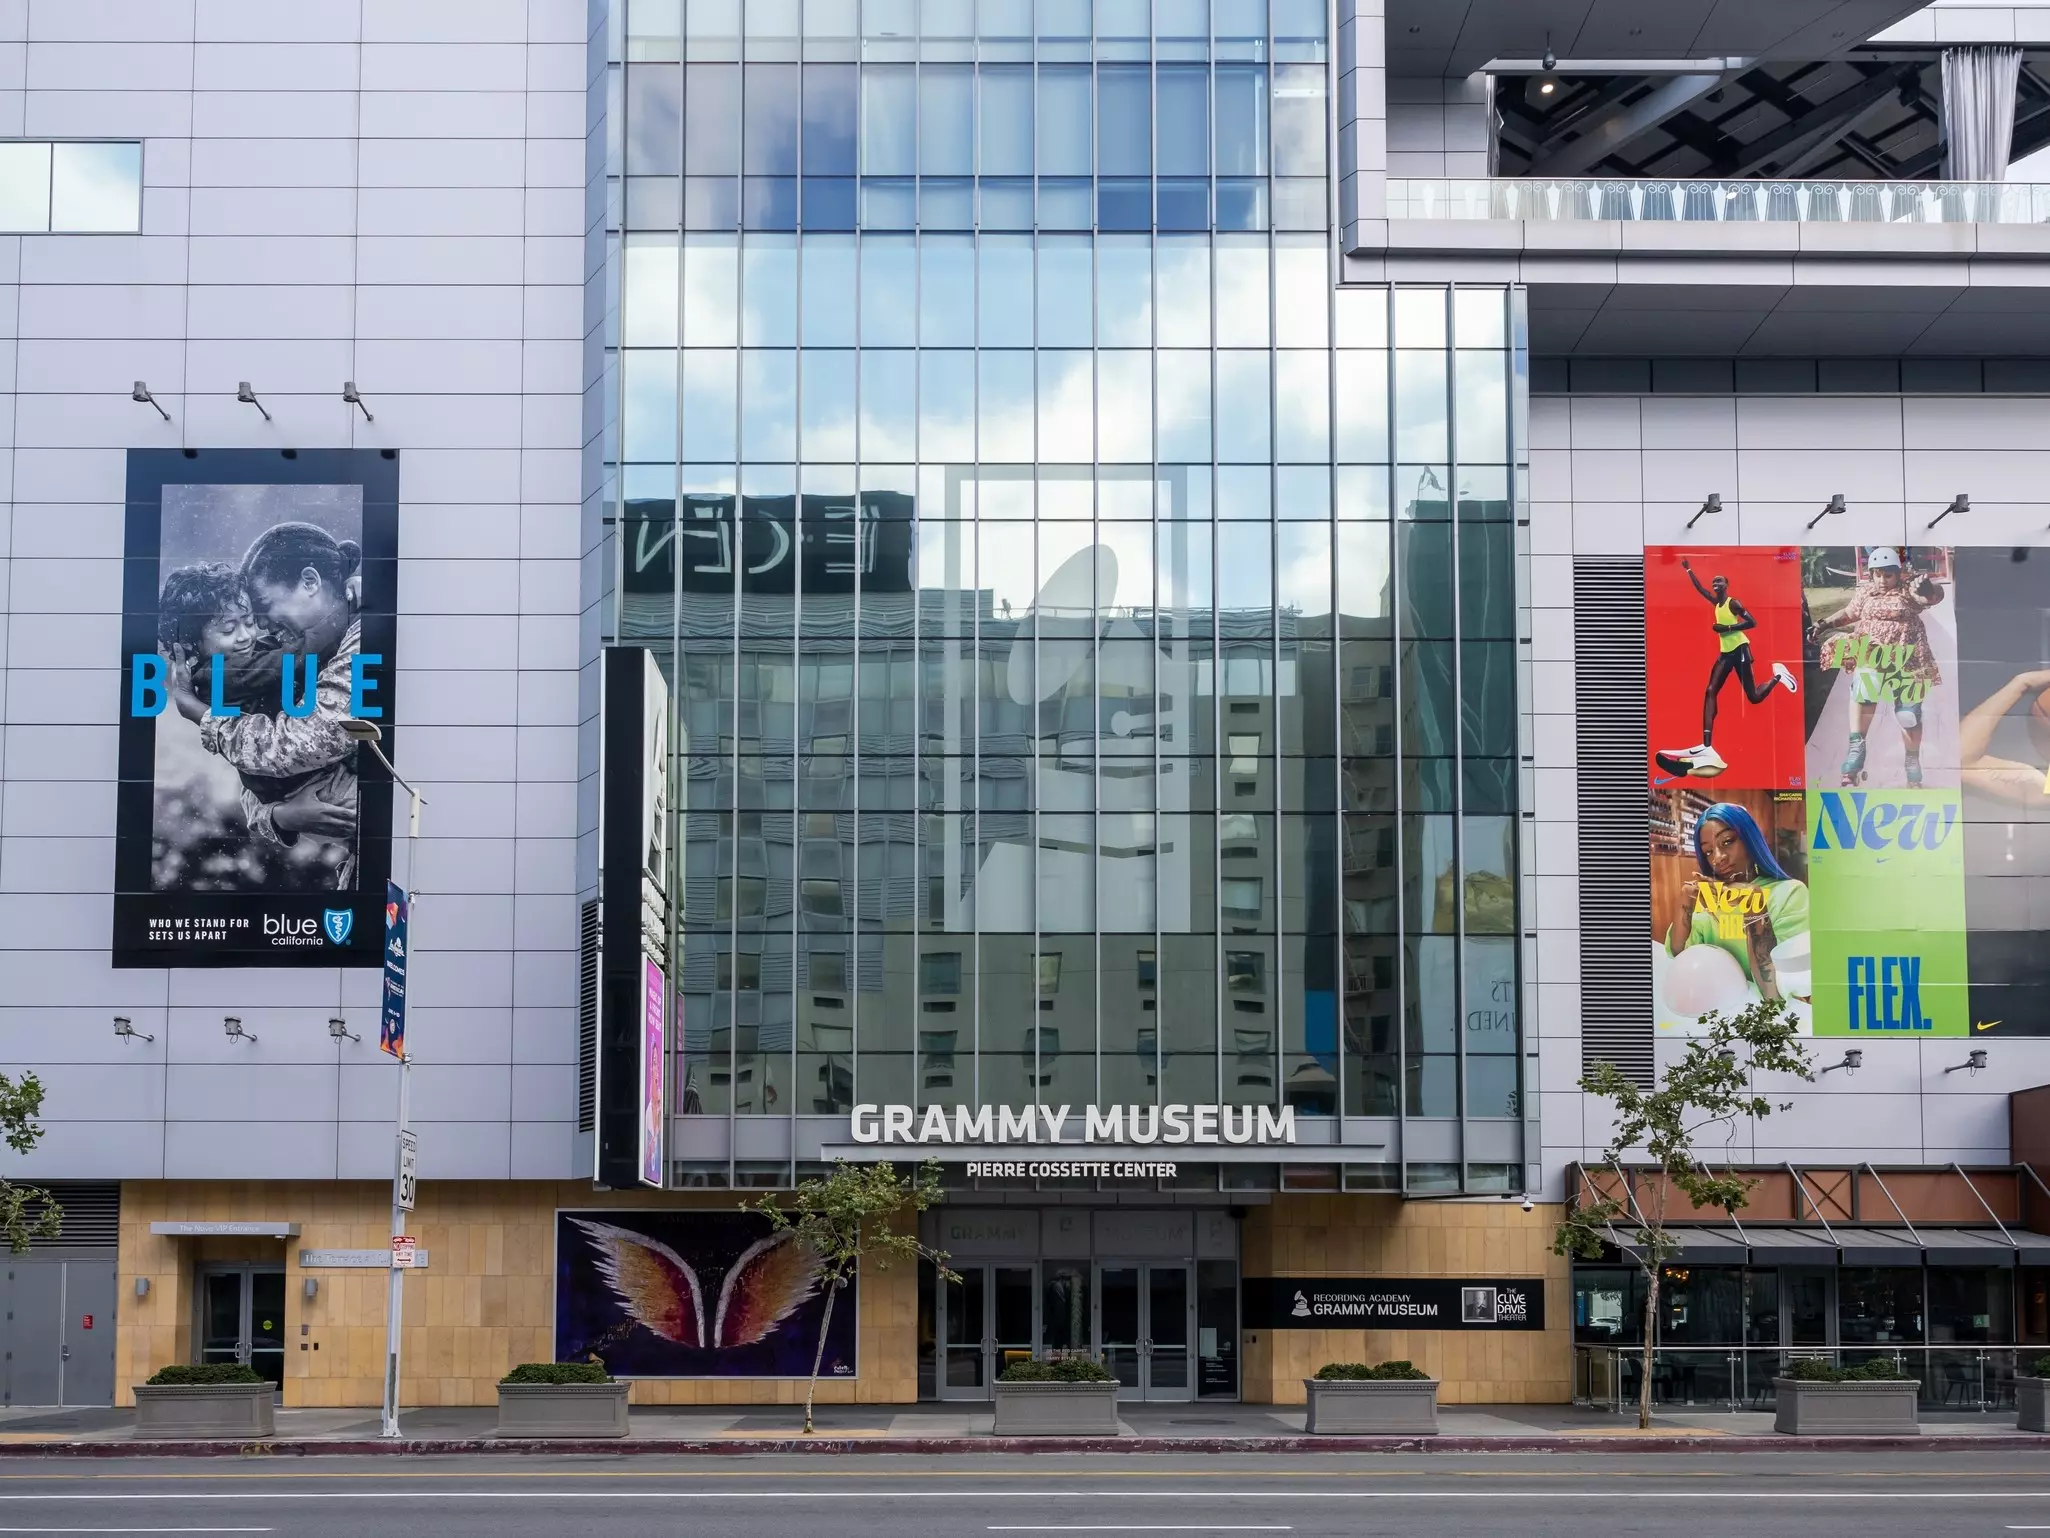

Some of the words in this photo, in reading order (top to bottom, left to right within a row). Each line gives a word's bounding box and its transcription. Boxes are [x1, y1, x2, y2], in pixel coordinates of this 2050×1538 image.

[1829, 633, 1916, 676] Play
[131, 653, 383, 718] BLUE
[1856, 672, 1933, 703] New
[1812, 792, 1958, 851] New
[1694, 881, 1770, 914] New
[149, 918, 171, 928] WHO
[175, 918, 190, 928] WE
[194, 918, 226, 928] STAND
[230, 918, 250, 928] FOR
[263, 913, 318, 935] blue
[149, 930, 174, 941] SETS
[177, 930, 191, 941] US
[194, 930, 227, 941] APART
[271, 936, 323, 946] california
[1847, 956, 1933, 1030] FLEX.
[850, 1104, 1070, 1143] GRAMMY
[1084, 1104, 1296, 1144] MUSEUM
[402, 1137, 416, 1152] SPEED
[403, 1155, 415, 1169] LIMIT
[966, 1162, 1026, 1178] PIERRE
[1028, 1162, 1111, 1178] COSSETTE
[1113, 1162, 1178, 1178] CENTER
[400, 1173, 415, 1203] 30
[1313, 1293, 1366, 1303] RECORDING
[1368, 1293, 1412, 1303] ACADEMY
[1497, 1293, 1527, 1304] CLIVE
[1313, 1303, 1376, 1316] GRAMMY
[1377, 1303, 1438, 1316] MUSEUM
[1497, 1304, 1527, 1314] DAVIS
[1498, 1313, 1527, 1321] THEATER
